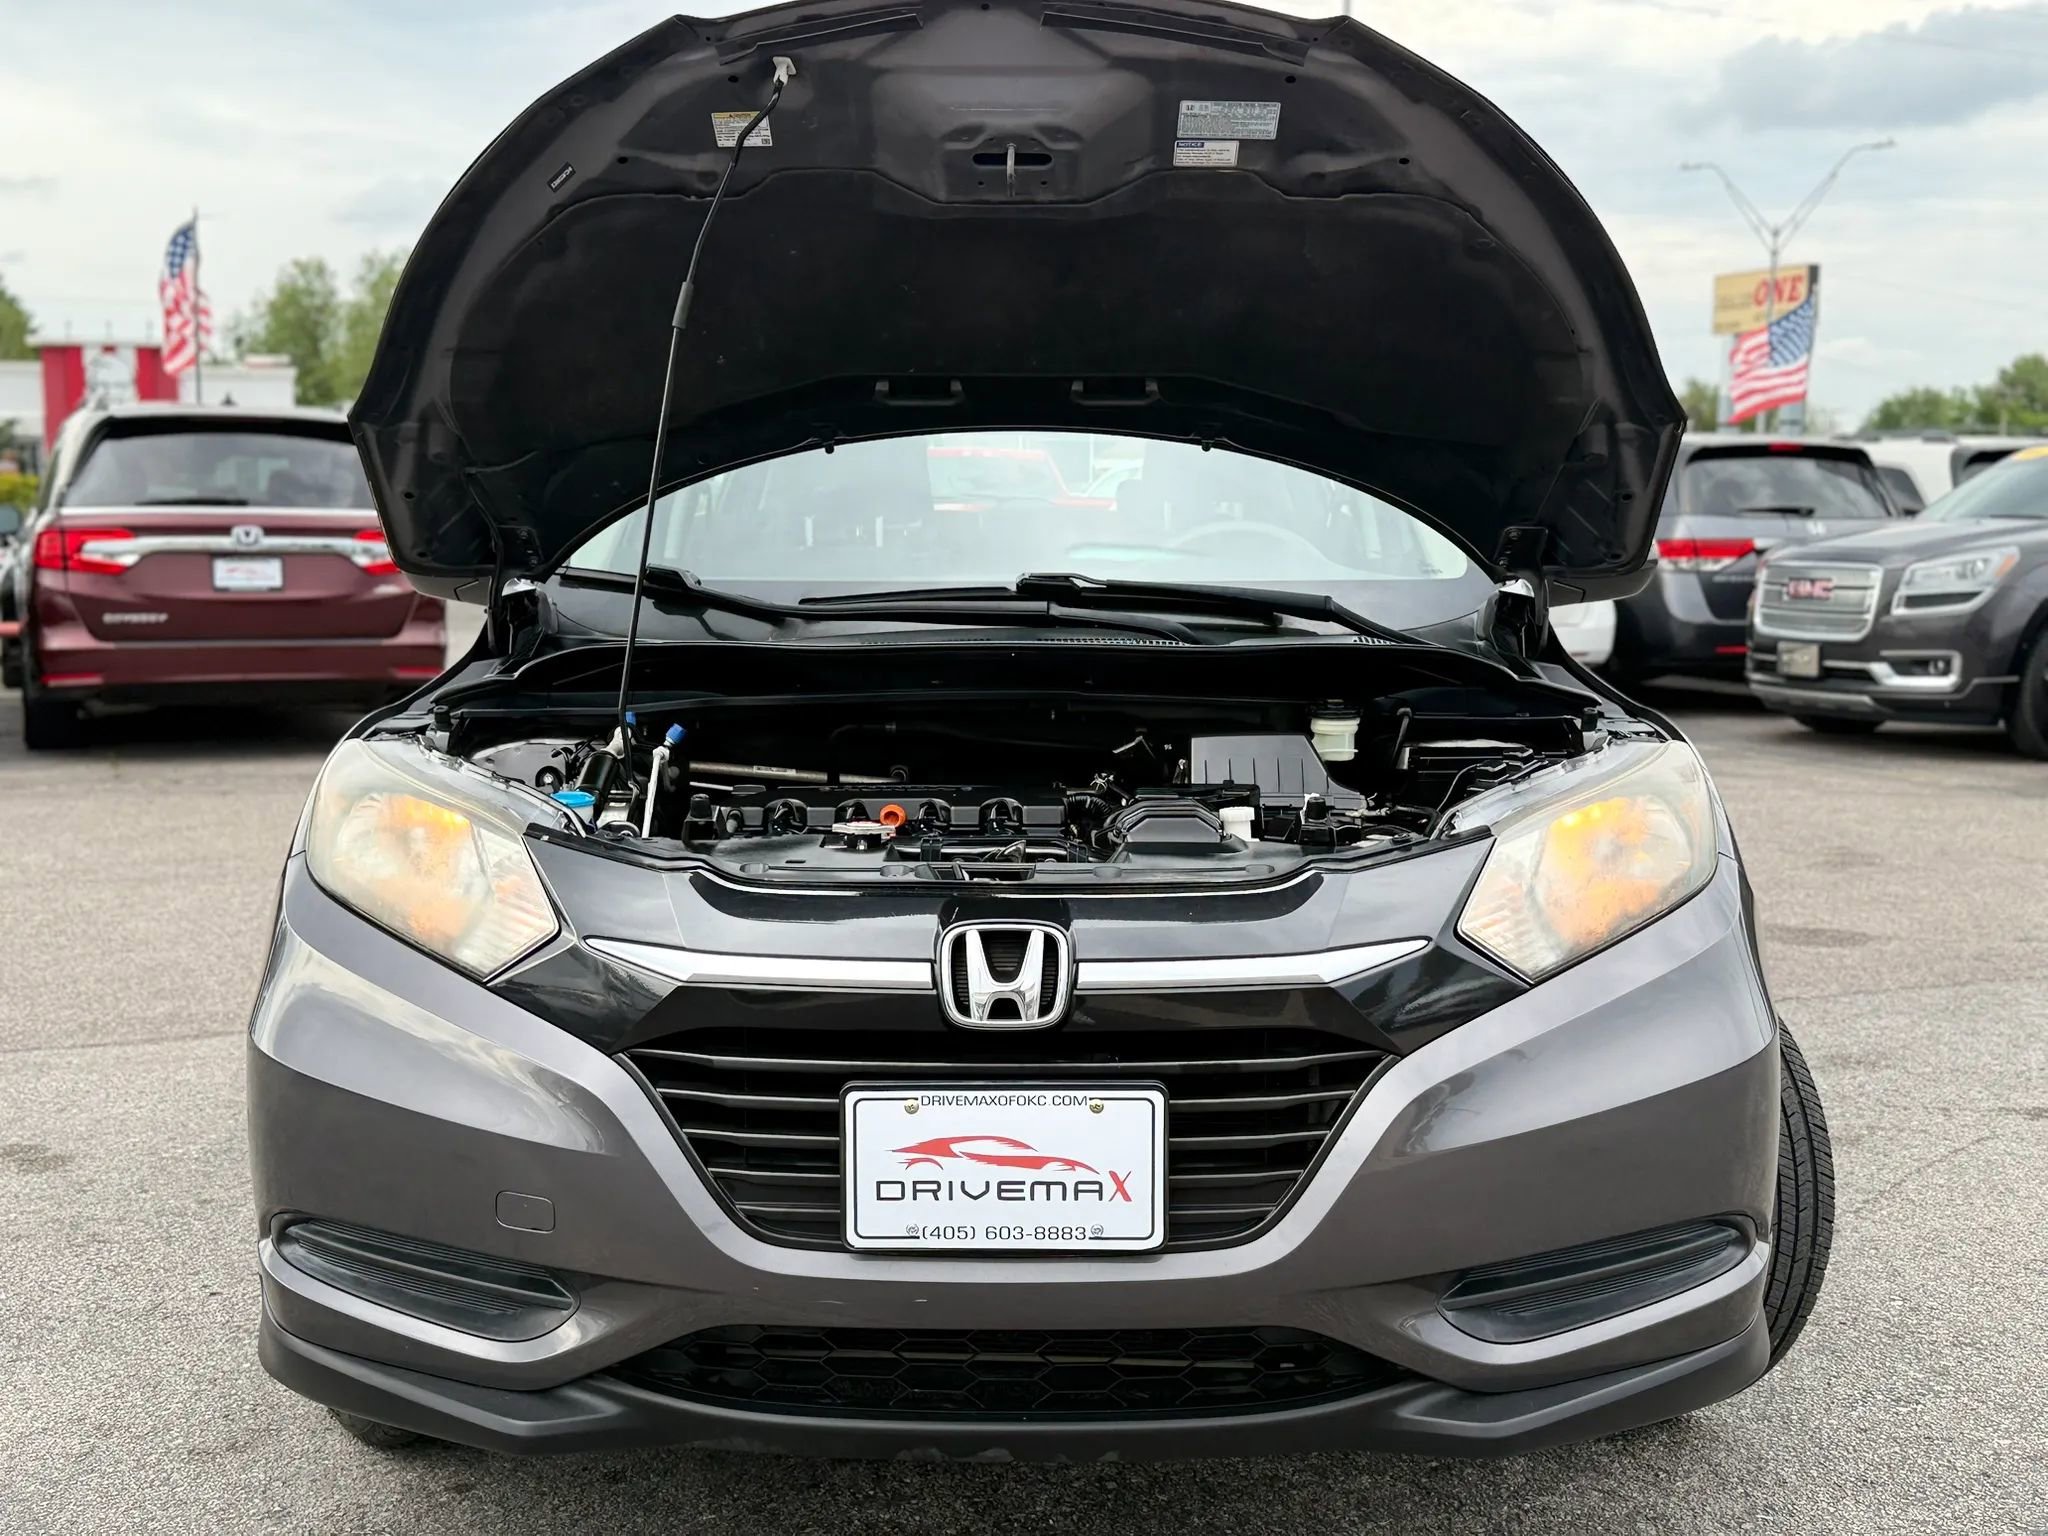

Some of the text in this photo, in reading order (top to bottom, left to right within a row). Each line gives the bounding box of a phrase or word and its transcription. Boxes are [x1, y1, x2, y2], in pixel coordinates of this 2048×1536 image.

[920, 1094, 1088, 1107] DRIVEMAXOFOKC.COM
[875, 1169, 1133, 1202] DRIVEMAX
[922, 1225, 1087, 1241] (405) 603-8883
